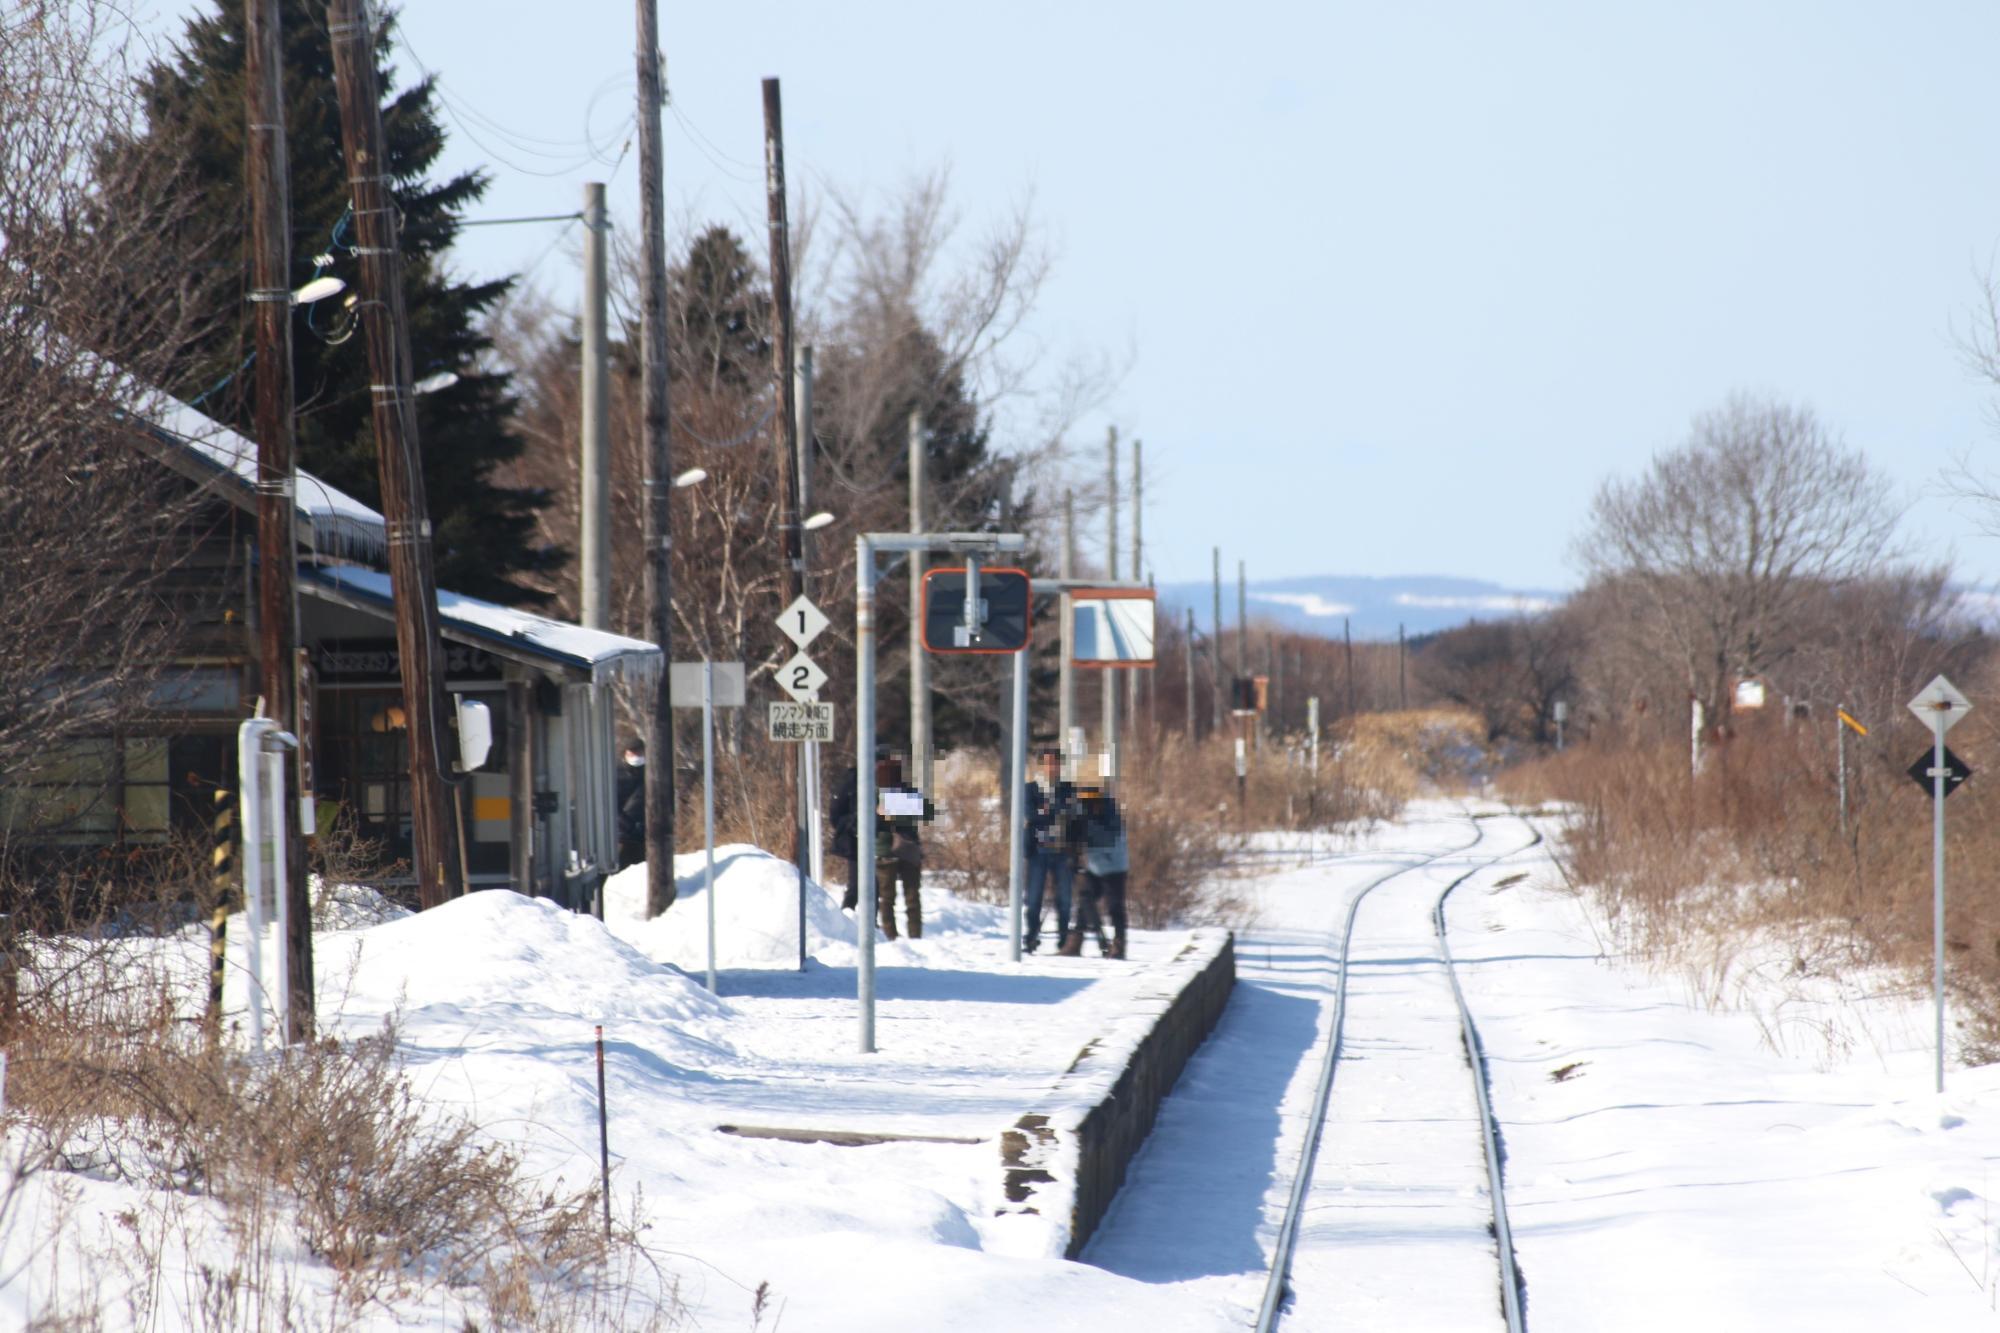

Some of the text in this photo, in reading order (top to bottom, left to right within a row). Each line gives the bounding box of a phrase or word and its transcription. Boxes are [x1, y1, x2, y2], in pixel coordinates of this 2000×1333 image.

[797, 610, 806, 635] 1
[792, 666, 809, 690] 2
[772, 721, 829, 739] 網走方面
